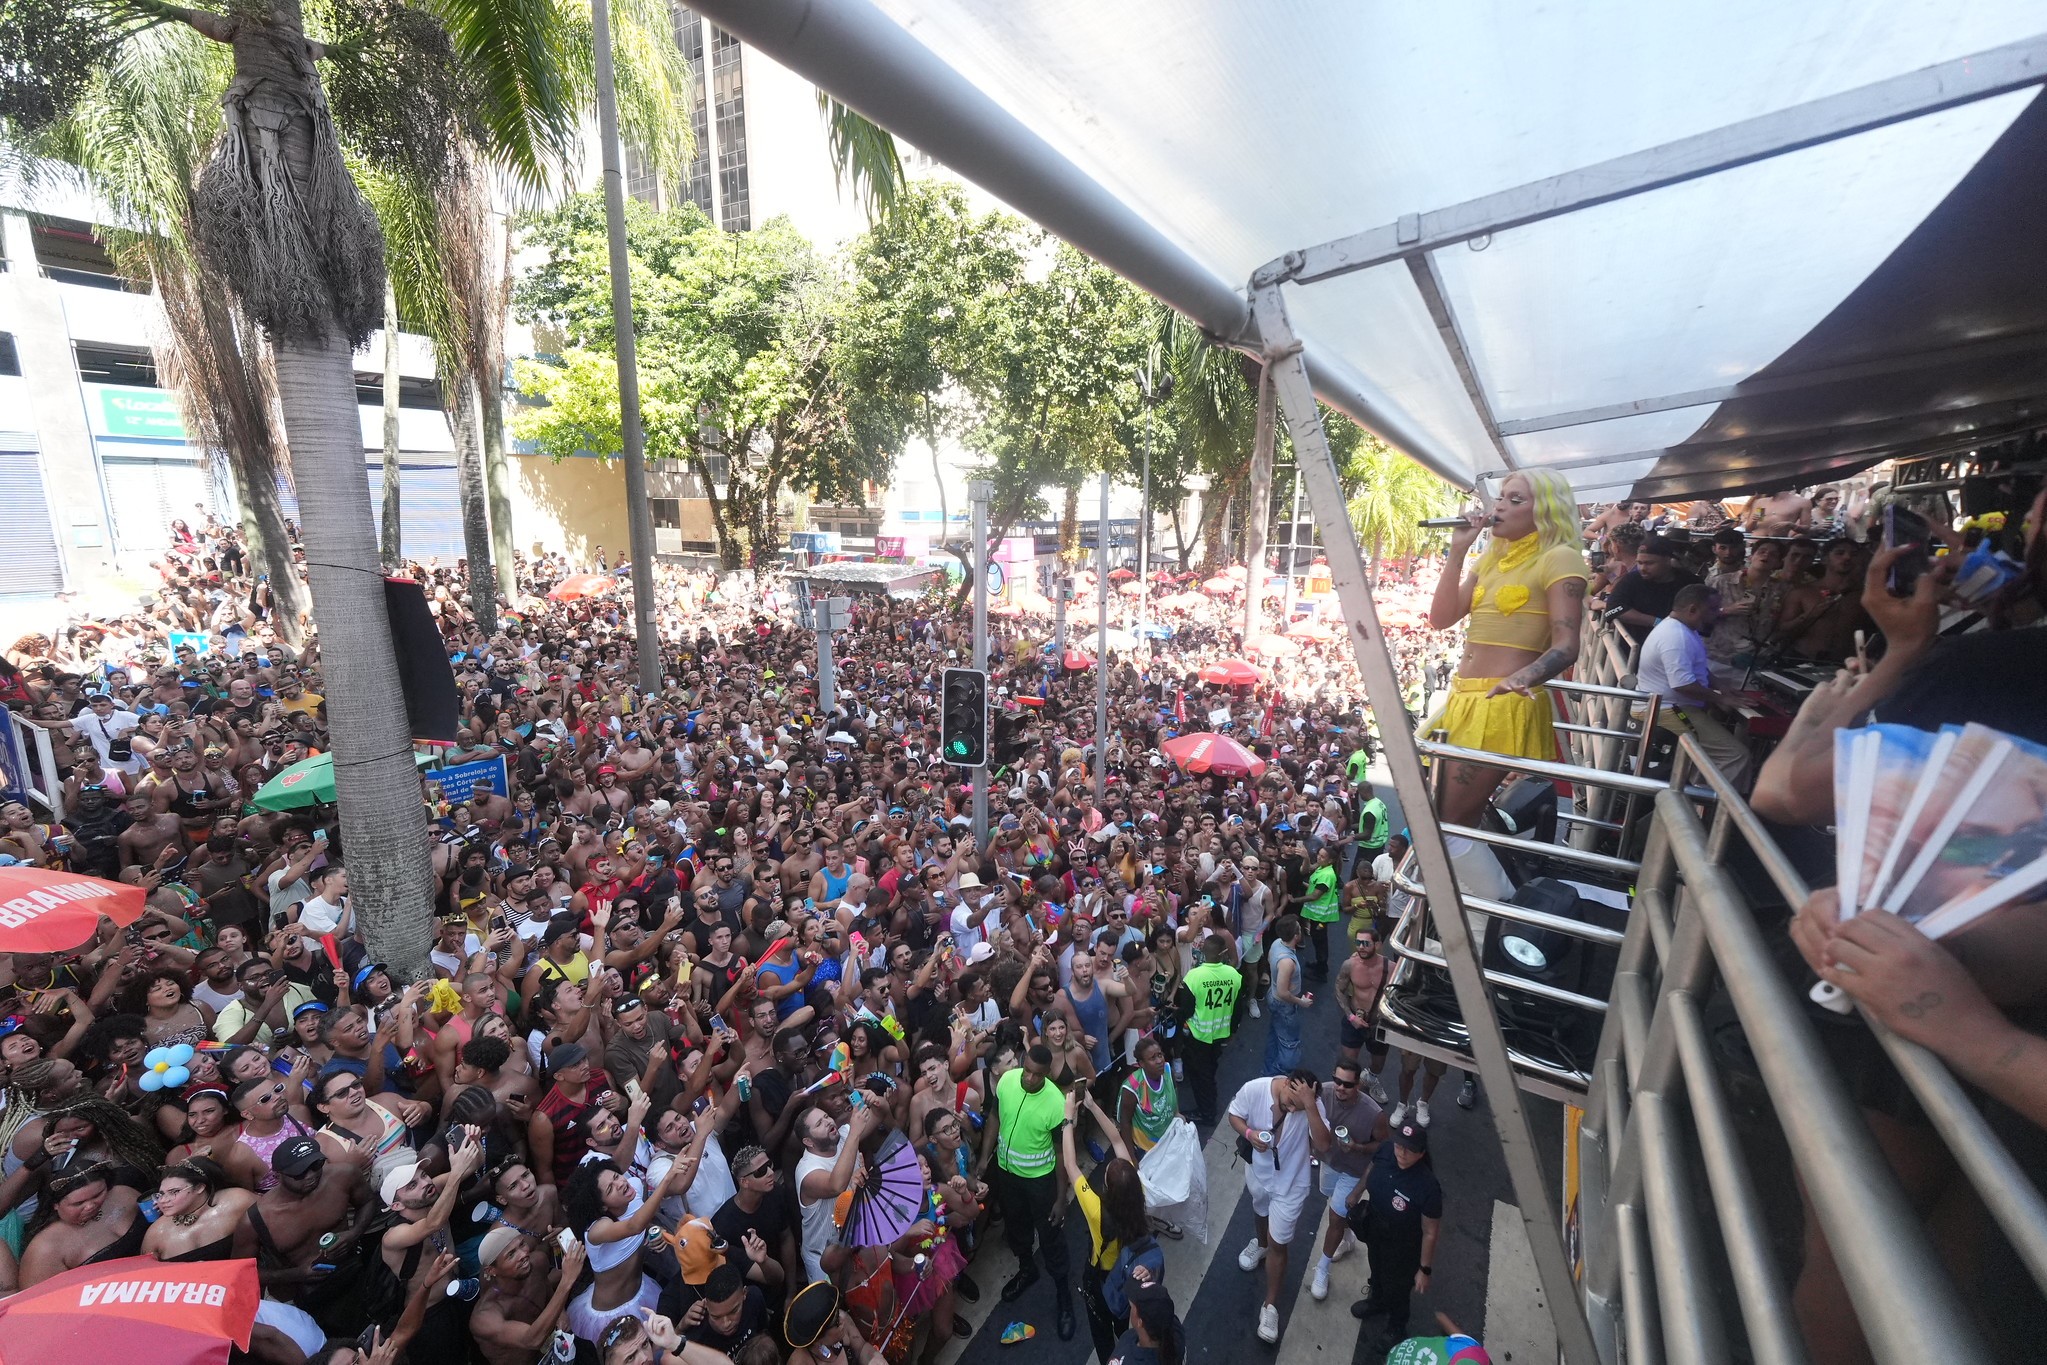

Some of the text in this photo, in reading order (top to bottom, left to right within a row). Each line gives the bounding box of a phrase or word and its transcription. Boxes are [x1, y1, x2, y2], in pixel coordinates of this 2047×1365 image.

[454, 768, 488, 781] Sobreloja
[445, 789, 459, 797] inal
[0, 881, 118, 929] BRAHMA
[1202, 979, 1234, 989] SEGURANÇA
[1204, 986, 1233, 1010] 424
[79, 1281, 227, 1307] BRAHMA
[1402, 1340, 1418, 1365] COLE
